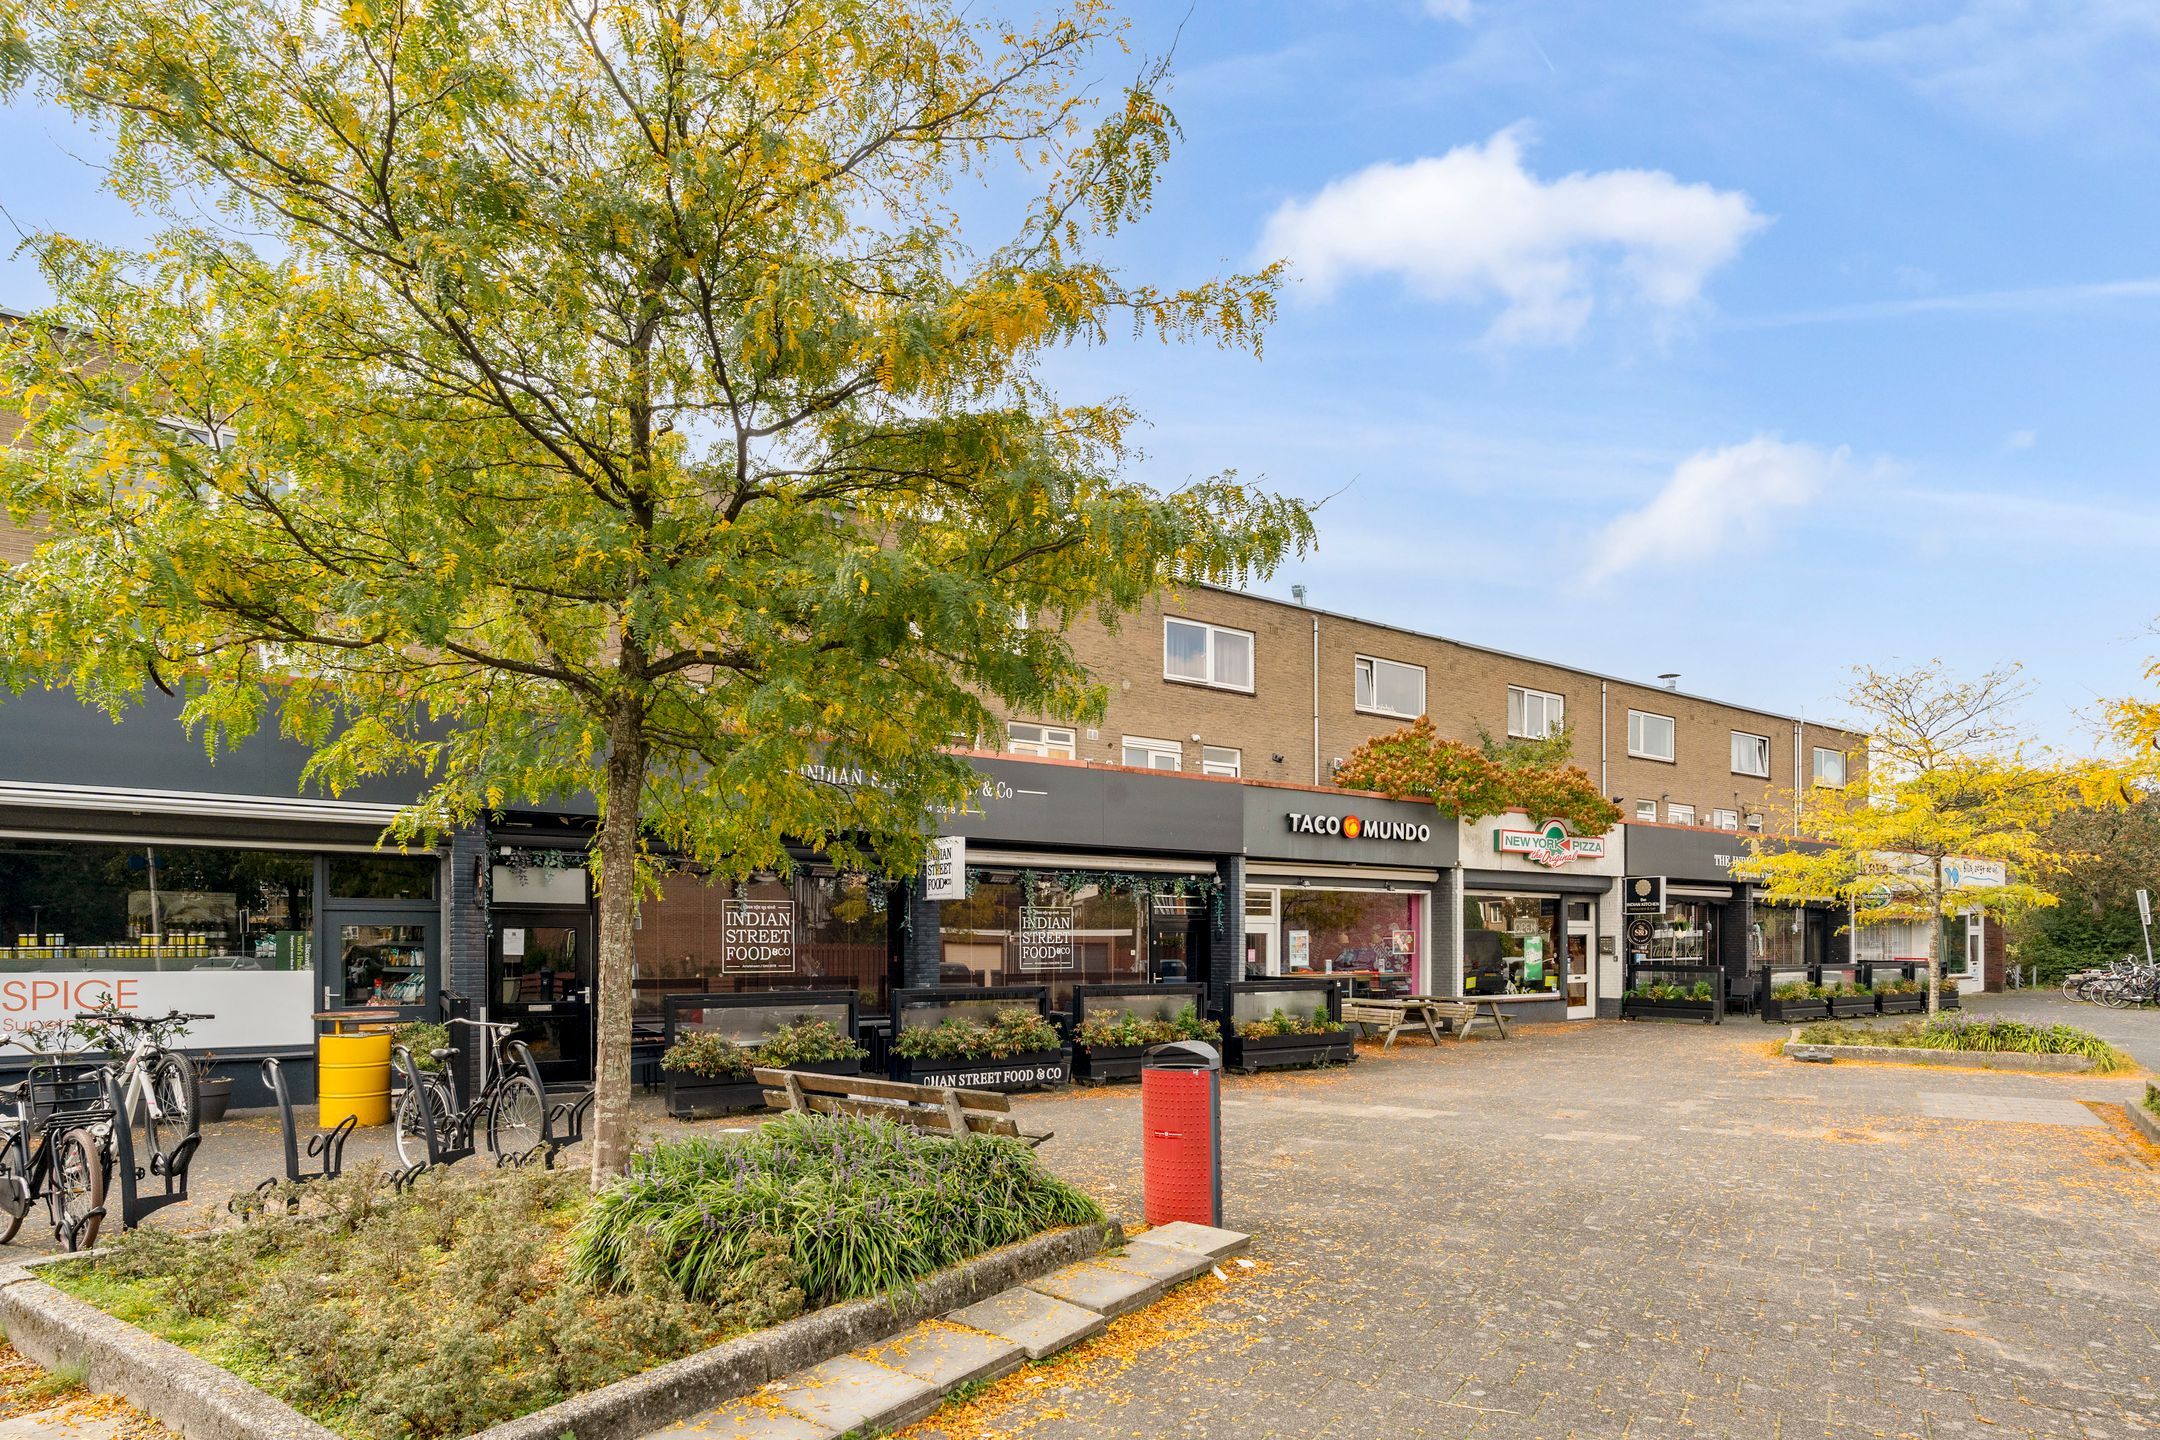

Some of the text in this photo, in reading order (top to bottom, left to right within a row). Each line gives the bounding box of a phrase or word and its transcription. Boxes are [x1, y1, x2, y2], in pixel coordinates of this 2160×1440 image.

[982, 780, 993, 797] &
[996, 781, 1013, 799] Co
[1288, 812, 1430, 842] TACO MUNDO
[1505, 835, 1602, 852] NEW YORK PIZZA
[1541, 850, 1578, 867] Original
[725, 911, 791, 926] INDIAN
[1022, 916, 1070, 929] INDIAN
[725, 929, 791, 944] STREET
[1022, 931, 1070, 944] STREET
[2, 979, 138, 1012] SPICE
[958, 1071, 1002, 1086] STREET
[1004, 1069, 1034, 1083] FOOD
[1036, 1067, 1045, 1081] &
[1046, 1067, 1062, 1080] CO
